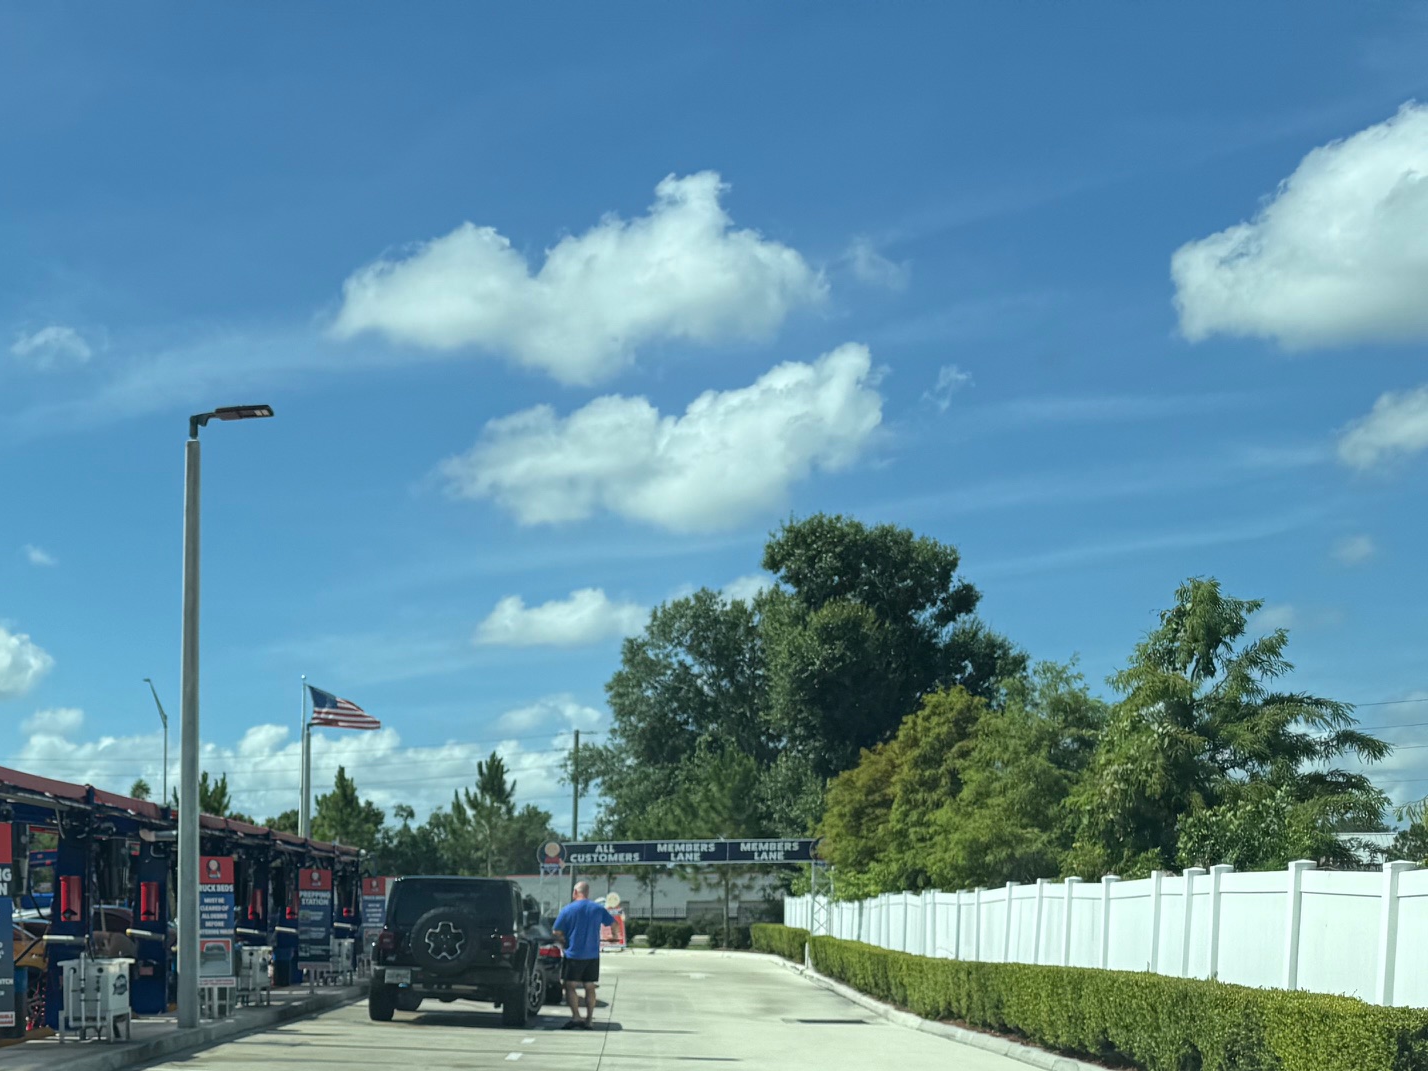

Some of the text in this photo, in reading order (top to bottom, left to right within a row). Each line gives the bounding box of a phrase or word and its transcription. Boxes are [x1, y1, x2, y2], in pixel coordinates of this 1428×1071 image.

[594, 844, 615, 853] ALL
[656, 843, 716, 853] MEMBERS
[740, 842, 800, 852] MEMBERS
[569, 852, 640, 863] CUSTOMERS
[670, 852, 701, 862] LANE
[753, 851, 785, 861] LANE
[217, 884, 234, 892] BEDS
